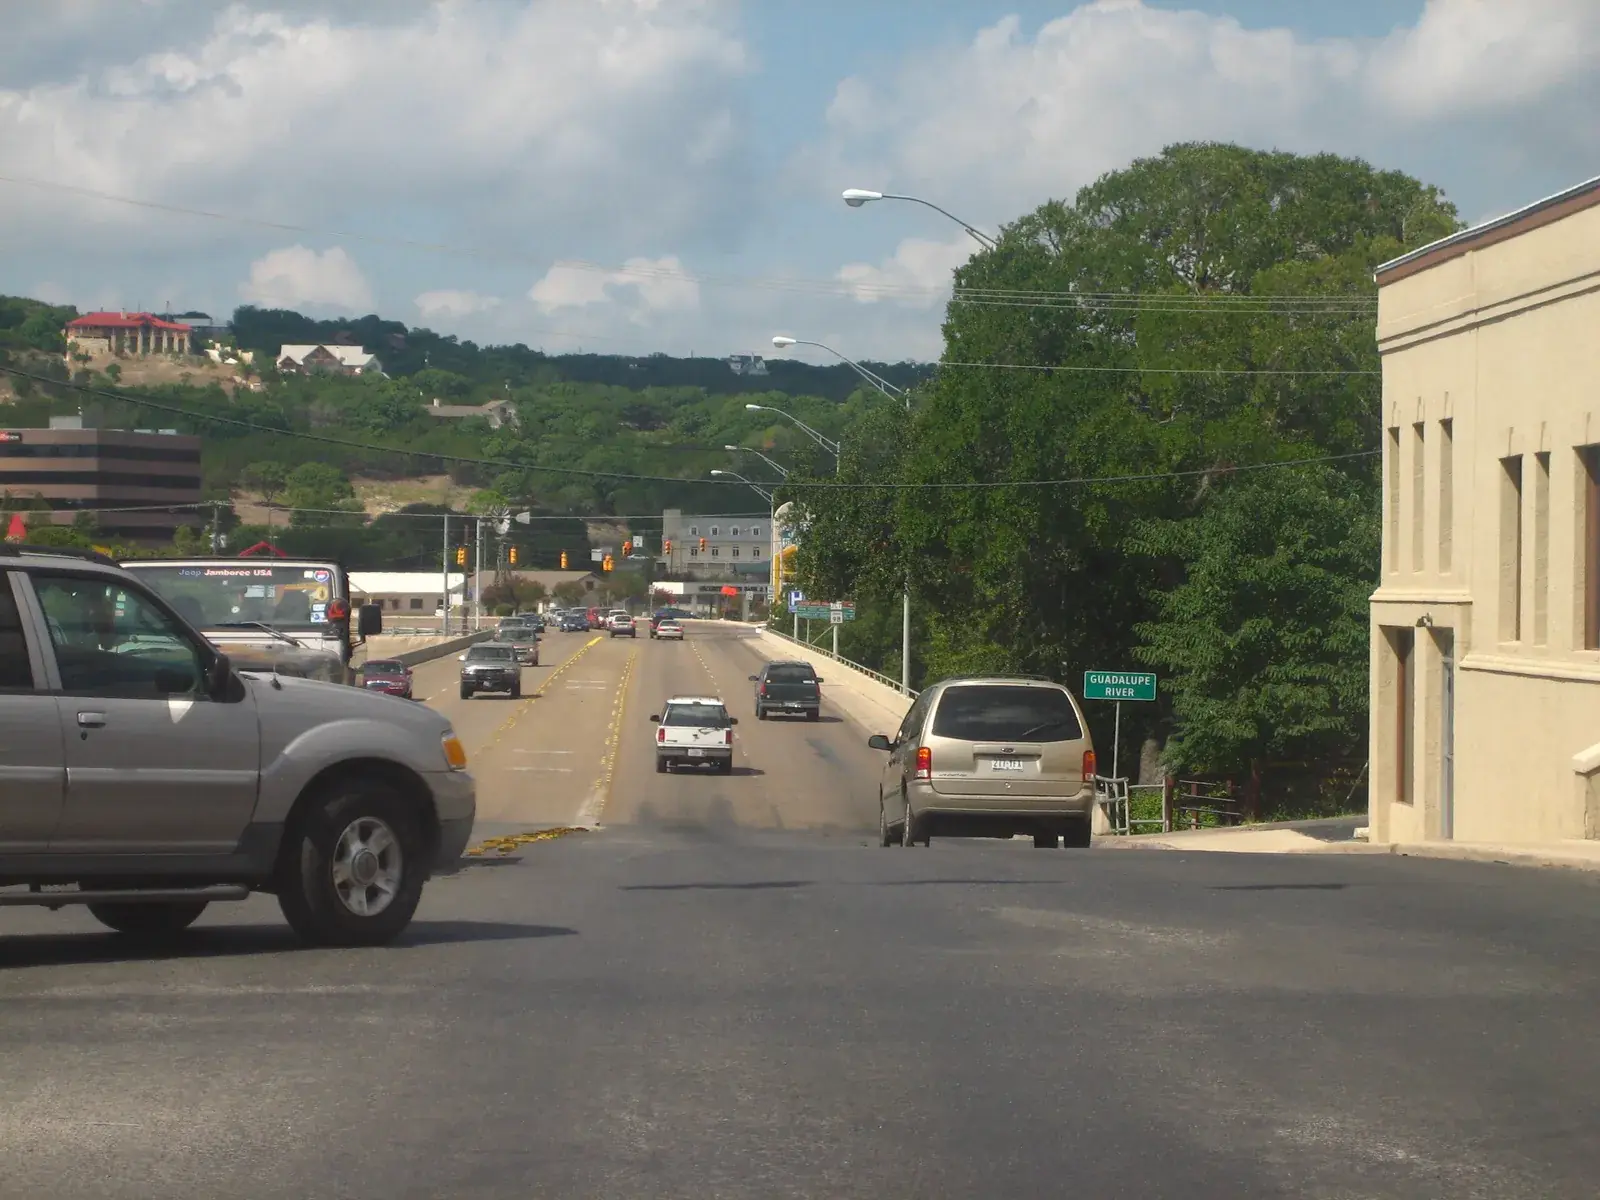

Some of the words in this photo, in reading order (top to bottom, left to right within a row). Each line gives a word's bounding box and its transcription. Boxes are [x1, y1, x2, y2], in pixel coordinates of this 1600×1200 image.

[179, 569, 201, 577] Jeep
[1090, 674, 1151, 686] GUADALUPE
[1105, 687, 1135, 697] RIVER
